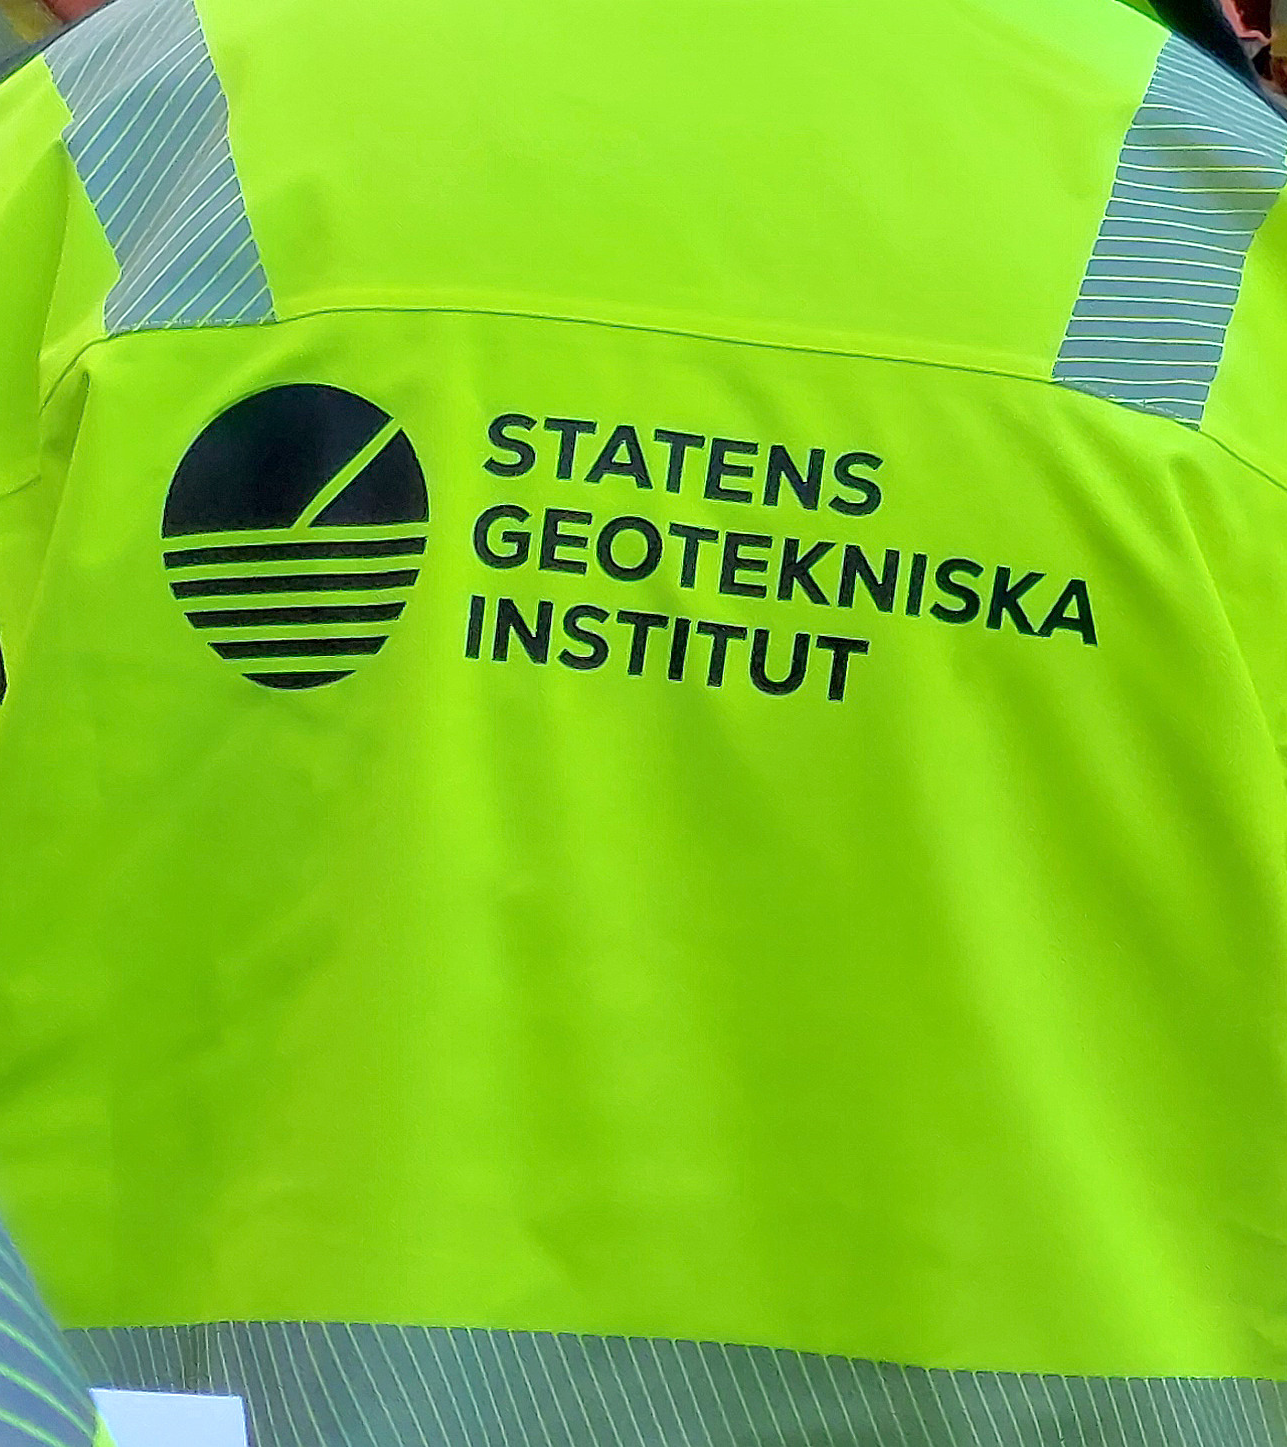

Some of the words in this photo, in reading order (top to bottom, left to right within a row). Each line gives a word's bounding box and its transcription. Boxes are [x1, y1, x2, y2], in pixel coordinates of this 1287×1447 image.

[481, 412, 884, 517] STATENS
[472, 503, 1098, 648] GEOTEKNISKA
[464, 593, 870, 703] INSTITUT
